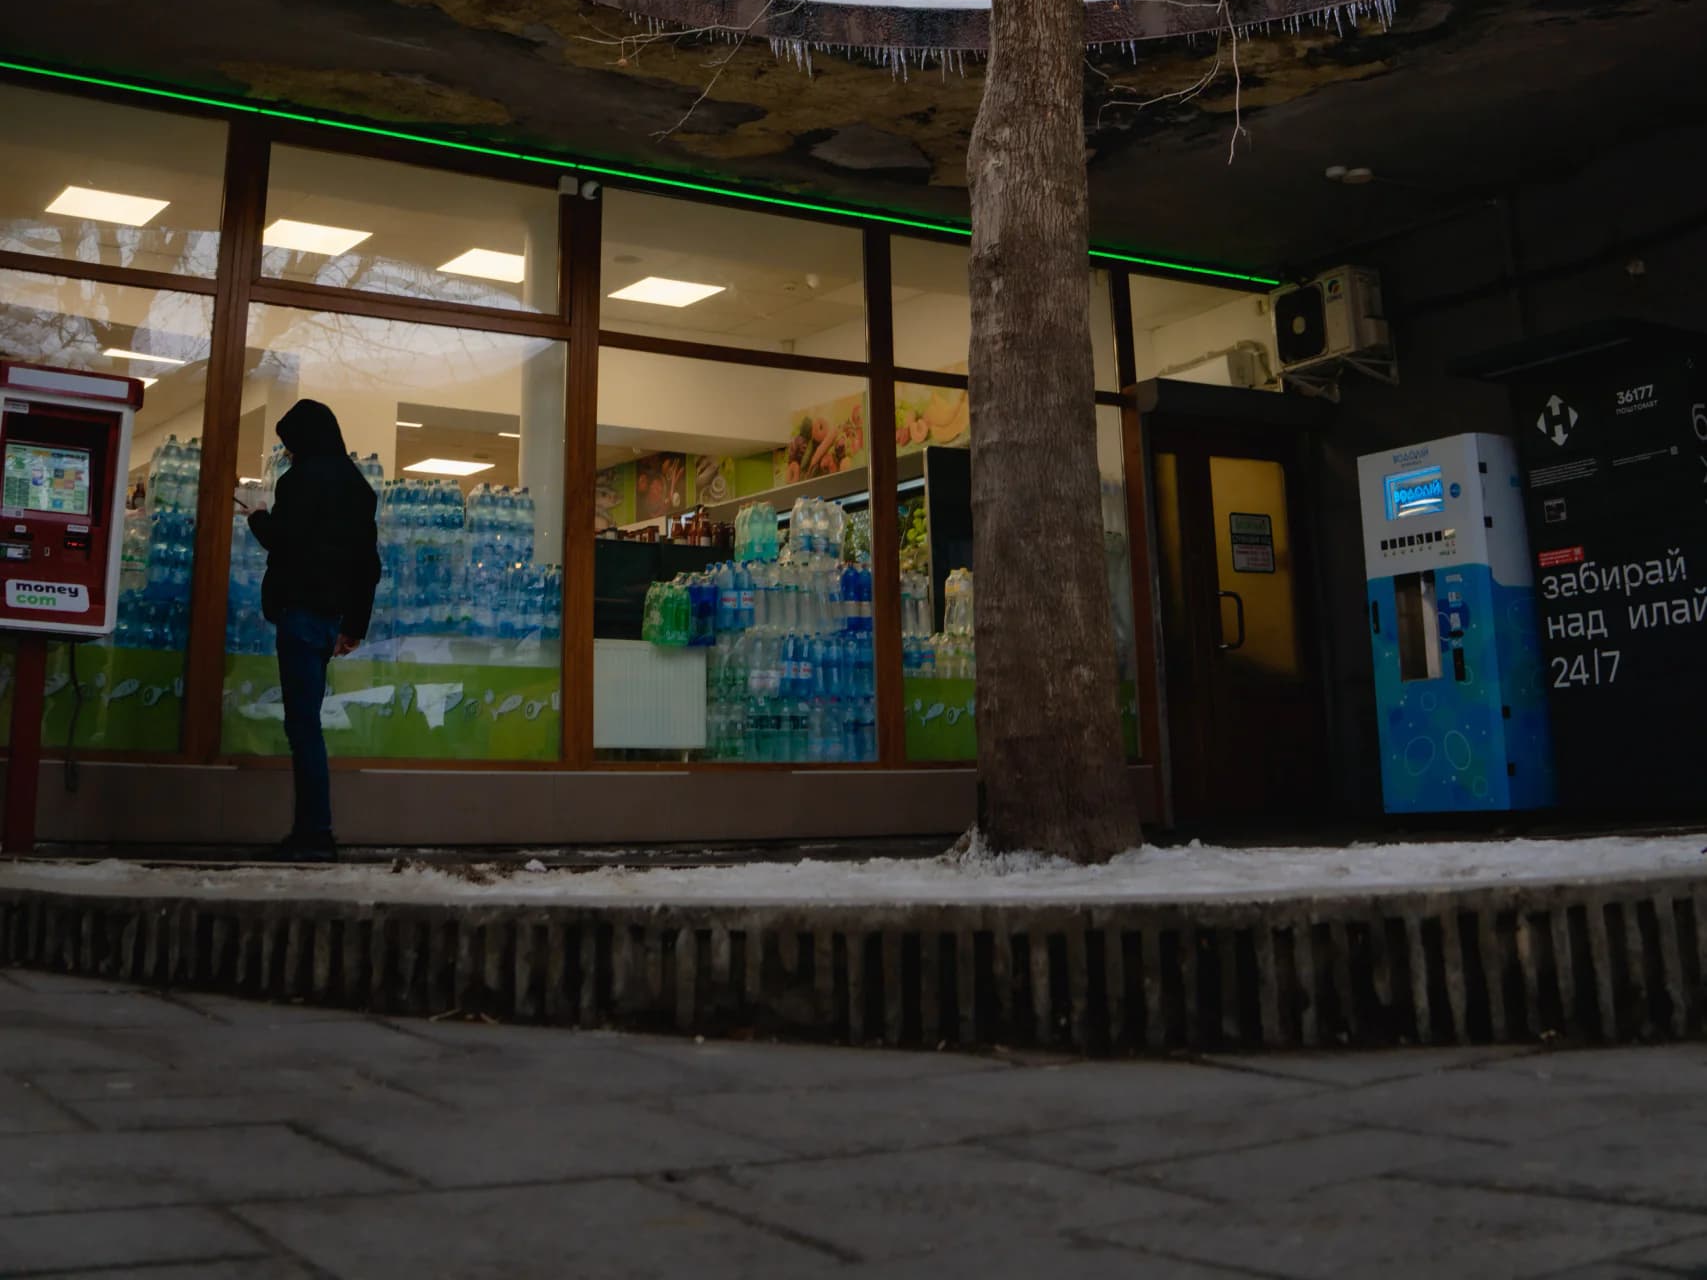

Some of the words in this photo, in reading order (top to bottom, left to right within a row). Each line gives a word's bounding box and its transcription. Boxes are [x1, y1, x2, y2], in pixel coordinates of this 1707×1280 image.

[1616, 383, 1653, 405] 36177
[1541, 547, 1688, 599] забирай
[15, 582, 80, 598] money
[15, 593, 57, 606] com
